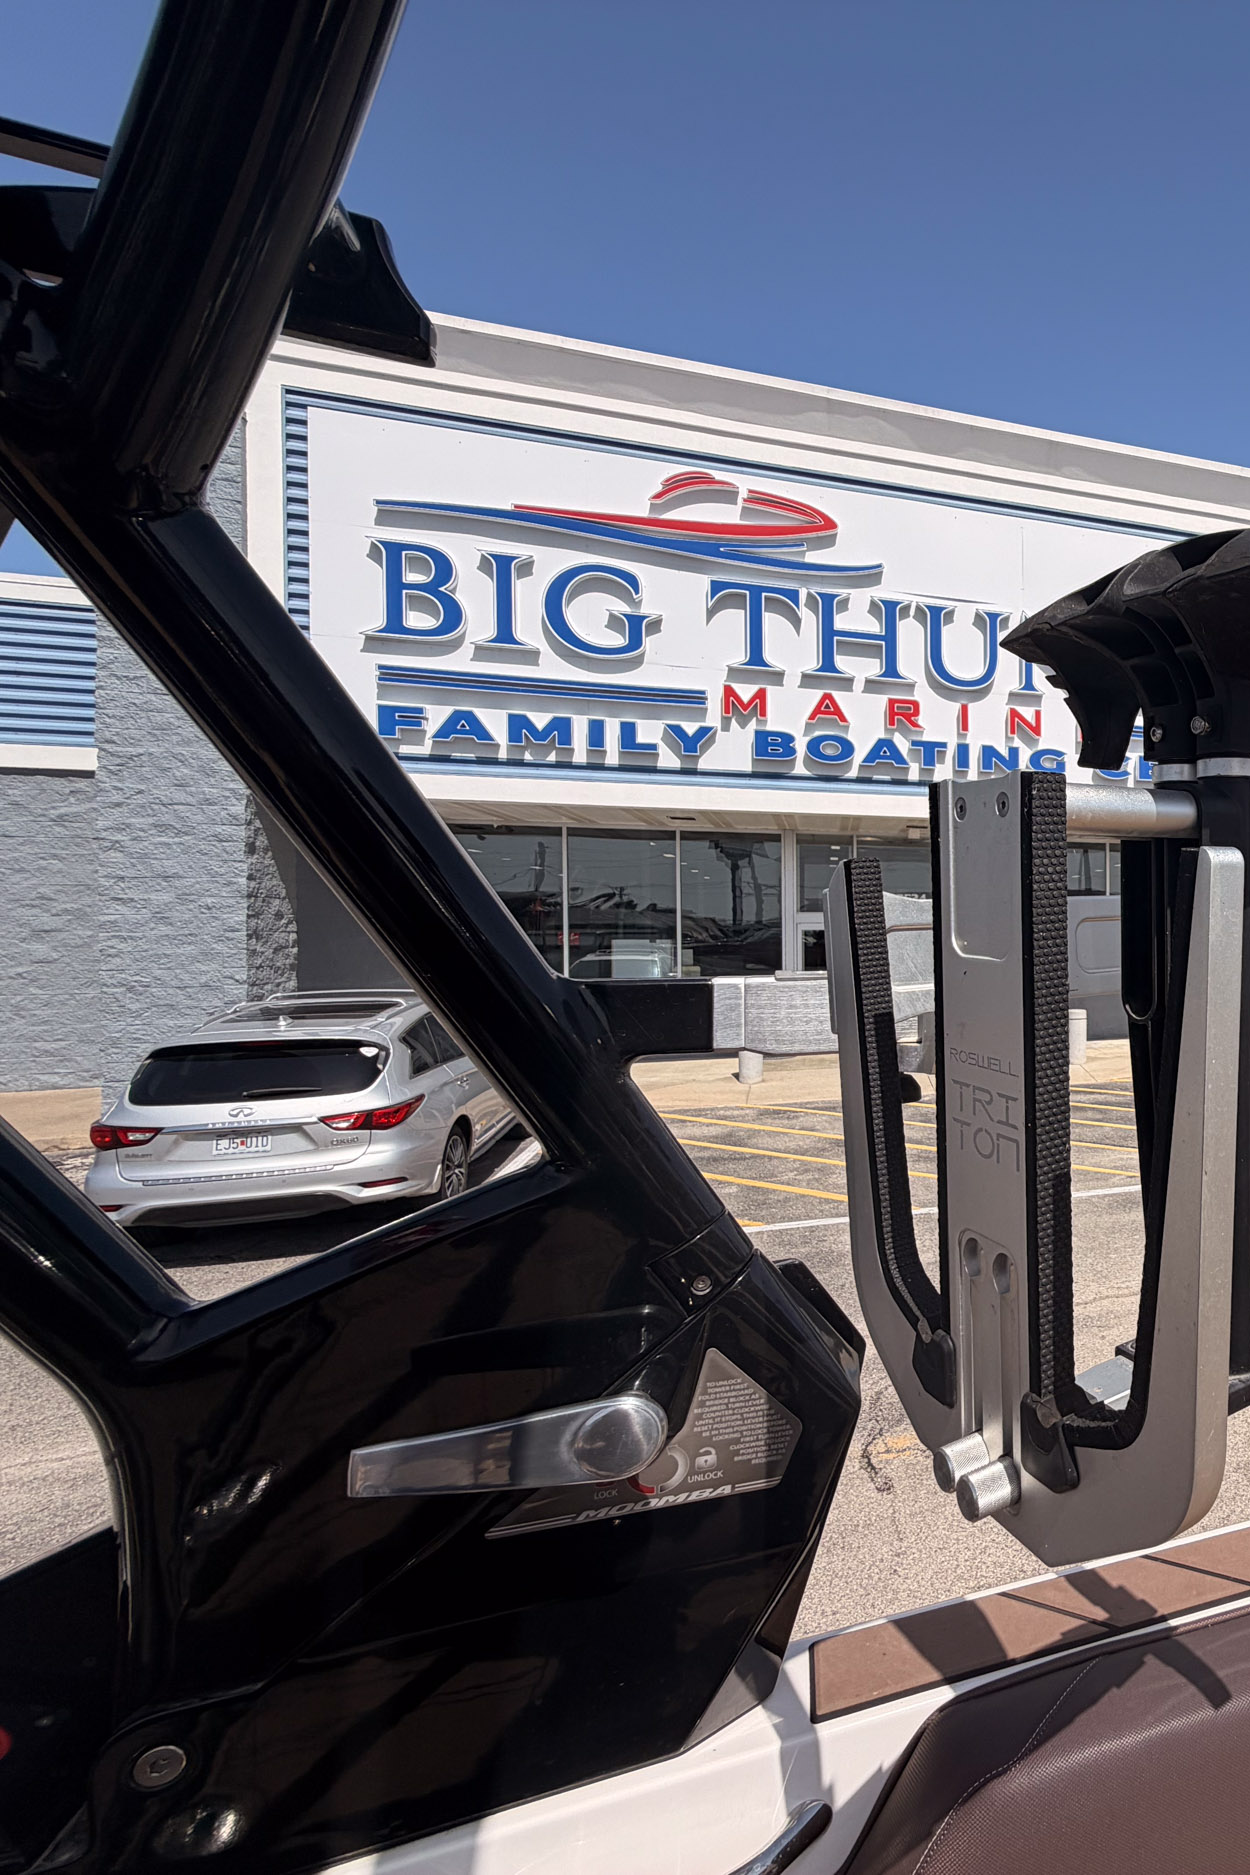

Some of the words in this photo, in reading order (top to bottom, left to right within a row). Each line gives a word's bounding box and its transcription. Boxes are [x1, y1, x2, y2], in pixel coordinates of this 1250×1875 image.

[360, 536, 663, 659] BIG
[722, 684, 1083, 743] MARIN
[377, 703, 718, 756] FAMILY
[753, 729, 1067, 773] BOATING
[950, 1048, 1019, 1078] ROSWELL
[951, 1078, 1019, 1131] TRI
[215, 1137, 239, 1151] EJ5
[716, 1378, 742, 1386] UNLOCK
[707, 1386, 729, 1394] TOWER
[716, 1388, 754, 1398] STARBOARD
[706, 1398, 728, 1406] BRIDGE
[745, 1398, 765, 1406] LEVER
[734, 1423, 762, 1431] POSITION
[729, 1440, 765, 1450] CLOCKWISE
[687, 1470, 724, 1484] UNLOCK
[594, 1488, 618, 1500] LOCK
[577, 1484, 732, 1521] MOOMBA
